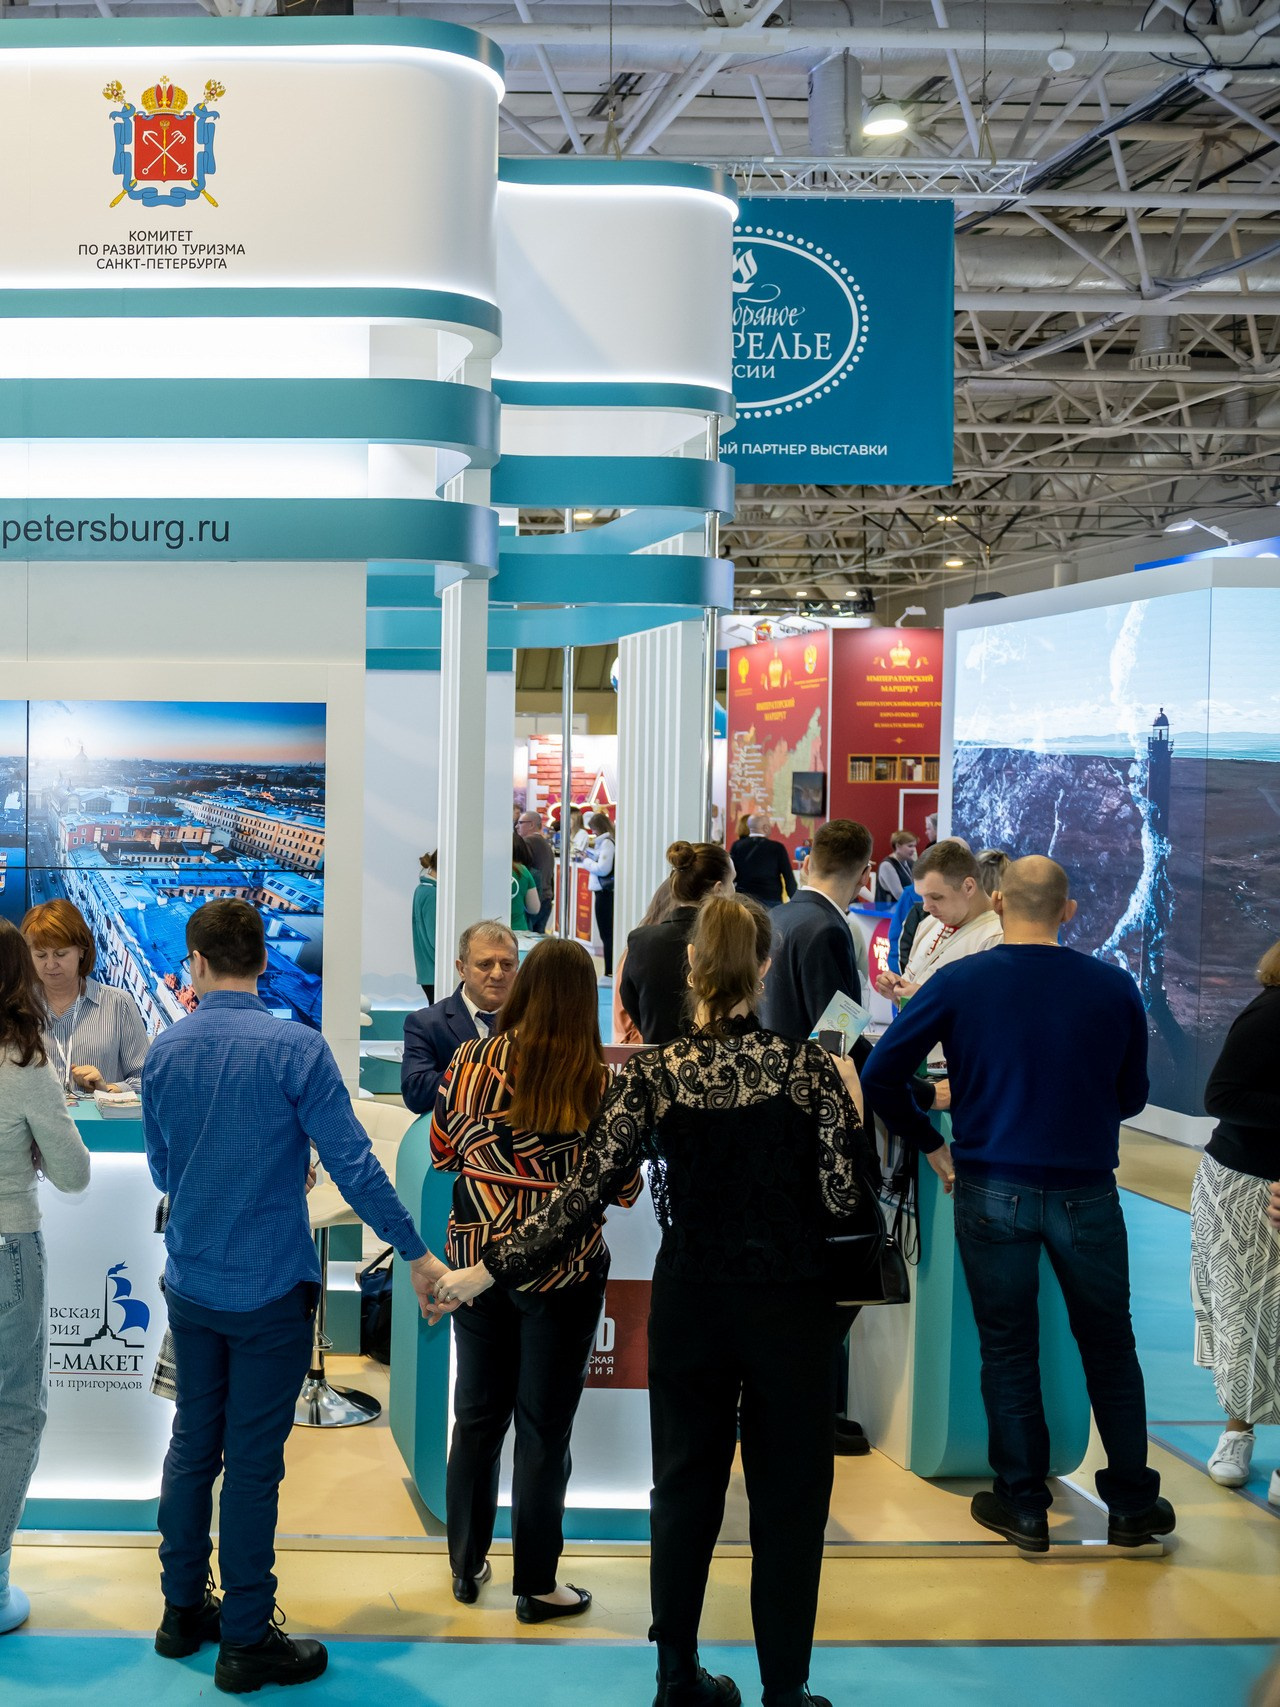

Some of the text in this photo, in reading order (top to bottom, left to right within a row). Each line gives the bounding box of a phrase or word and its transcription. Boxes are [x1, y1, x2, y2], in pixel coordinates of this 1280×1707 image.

[129, 230, 193, 242] КОМИТЕТ
[78, 244, 246, 256] ПО РАЗВИТИЮ ТУРИЗМА
[96, 258, 228, 270] САНКТ-ПЕТЕРБУРГА
[732, 364, 776, 379] СИИ
[742, 443, 808, 456] ПАРТНЕР
[810, 444, 888, 457] ВЫСТАВКИ
[49, 1352, 144, 1372] -МАКЕТ
[67, 1380, 143, 1392] пригородов
